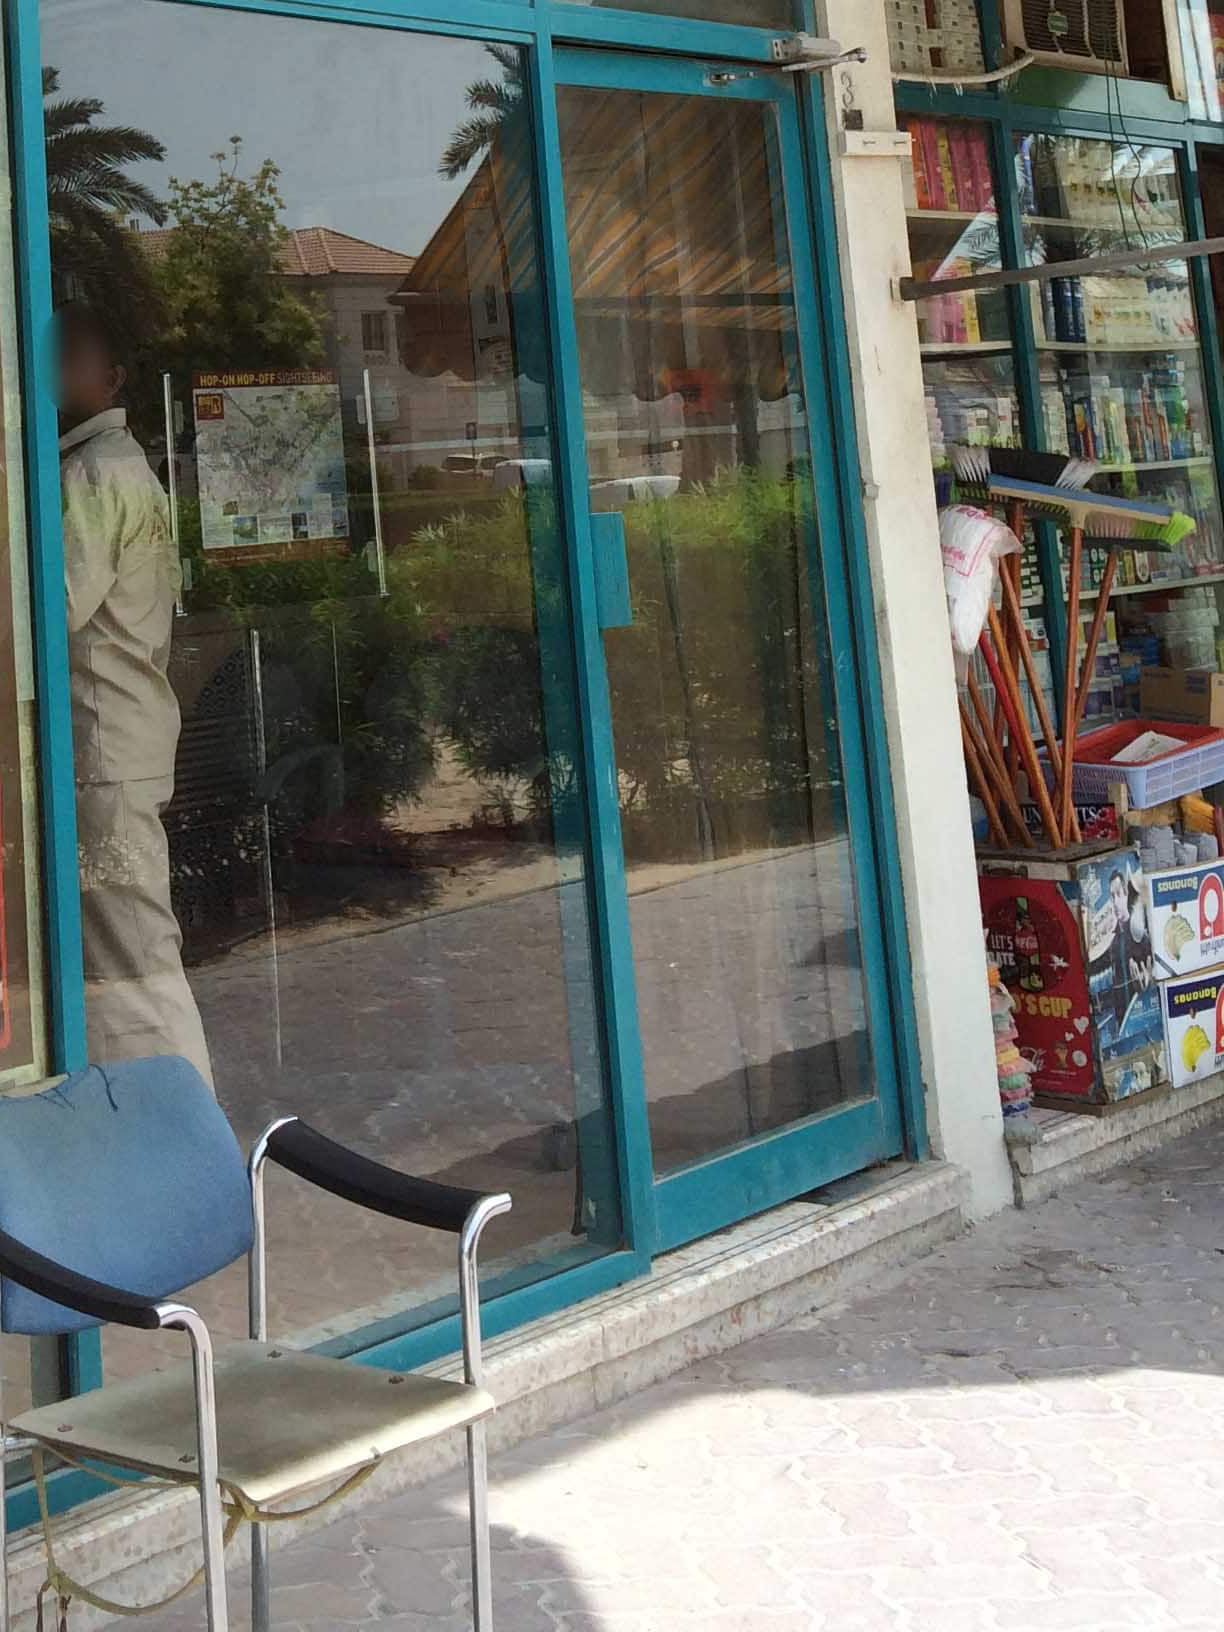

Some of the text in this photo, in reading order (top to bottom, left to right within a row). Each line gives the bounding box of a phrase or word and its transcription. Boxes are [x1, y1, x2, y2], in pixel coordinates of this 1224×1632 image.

[200, 374, 235, 386] HOP-ON
[236, 372, 275, 385] HOP-OFF
[1157, 876, 1199, 893] Bananas
[1173, 986, 1217, 1005] Bananas
